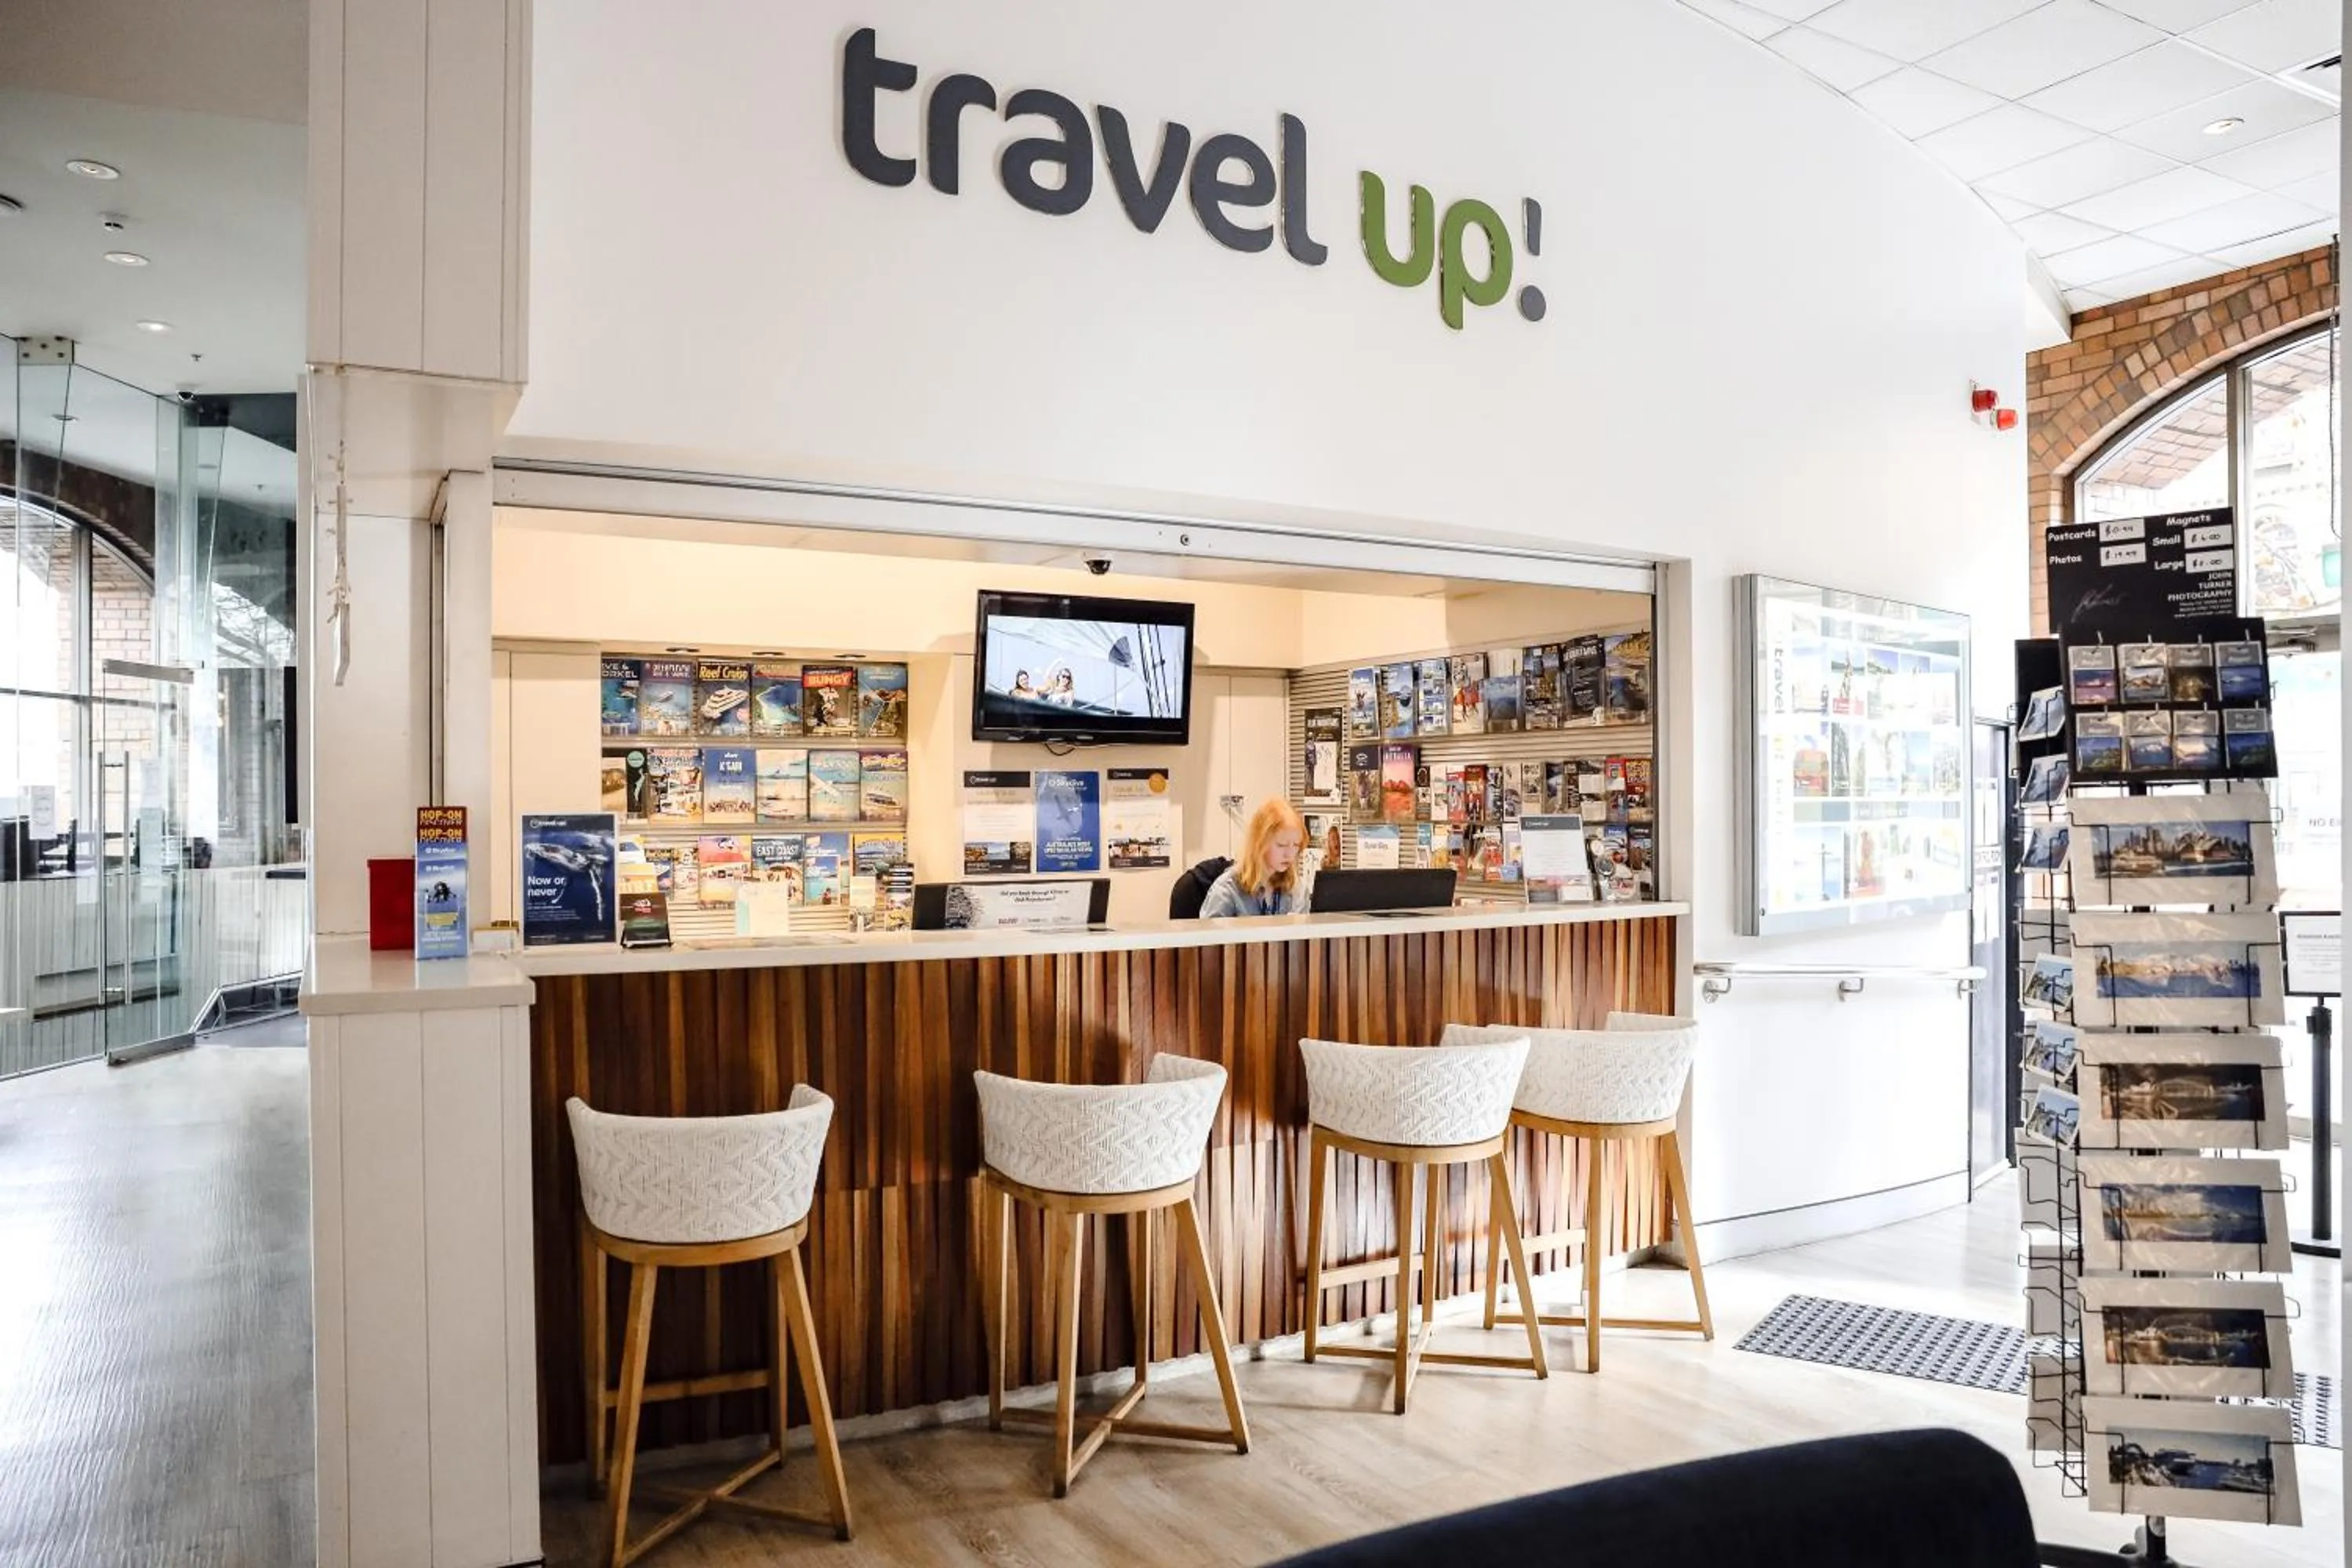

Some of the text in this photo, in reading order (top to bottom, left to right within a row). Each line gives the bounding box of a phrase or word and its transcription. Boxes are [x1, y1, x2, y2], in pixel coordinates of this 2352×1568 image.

[842, 27, 1548, 331] travel up!
[2166, 514, 2211, 527] Magnets
[2048, 528, 2096, 542] Postcards
[2152, 534, 2180, 546] Small
[2049, 554, 2082, 564] Photos
[2154, 560, 2184, 571] Large
[2208, 572, 2232, 580] JOHN
[2198, 580, 2233, 590] TURNER
[2168, 590, 2233, 602] PHOTOGRAPHY
[699, 666, 721, 678] Reef
[808, 673, 851, 684] BUNGY
[1774, 648, 1786, 714] travel
[419, 810, 462, 819] HOP-ON
[419, 828, 463, 837] HOP-ON
[528, 876, 551, 885] Now
[527, 887, 557, 897] never
